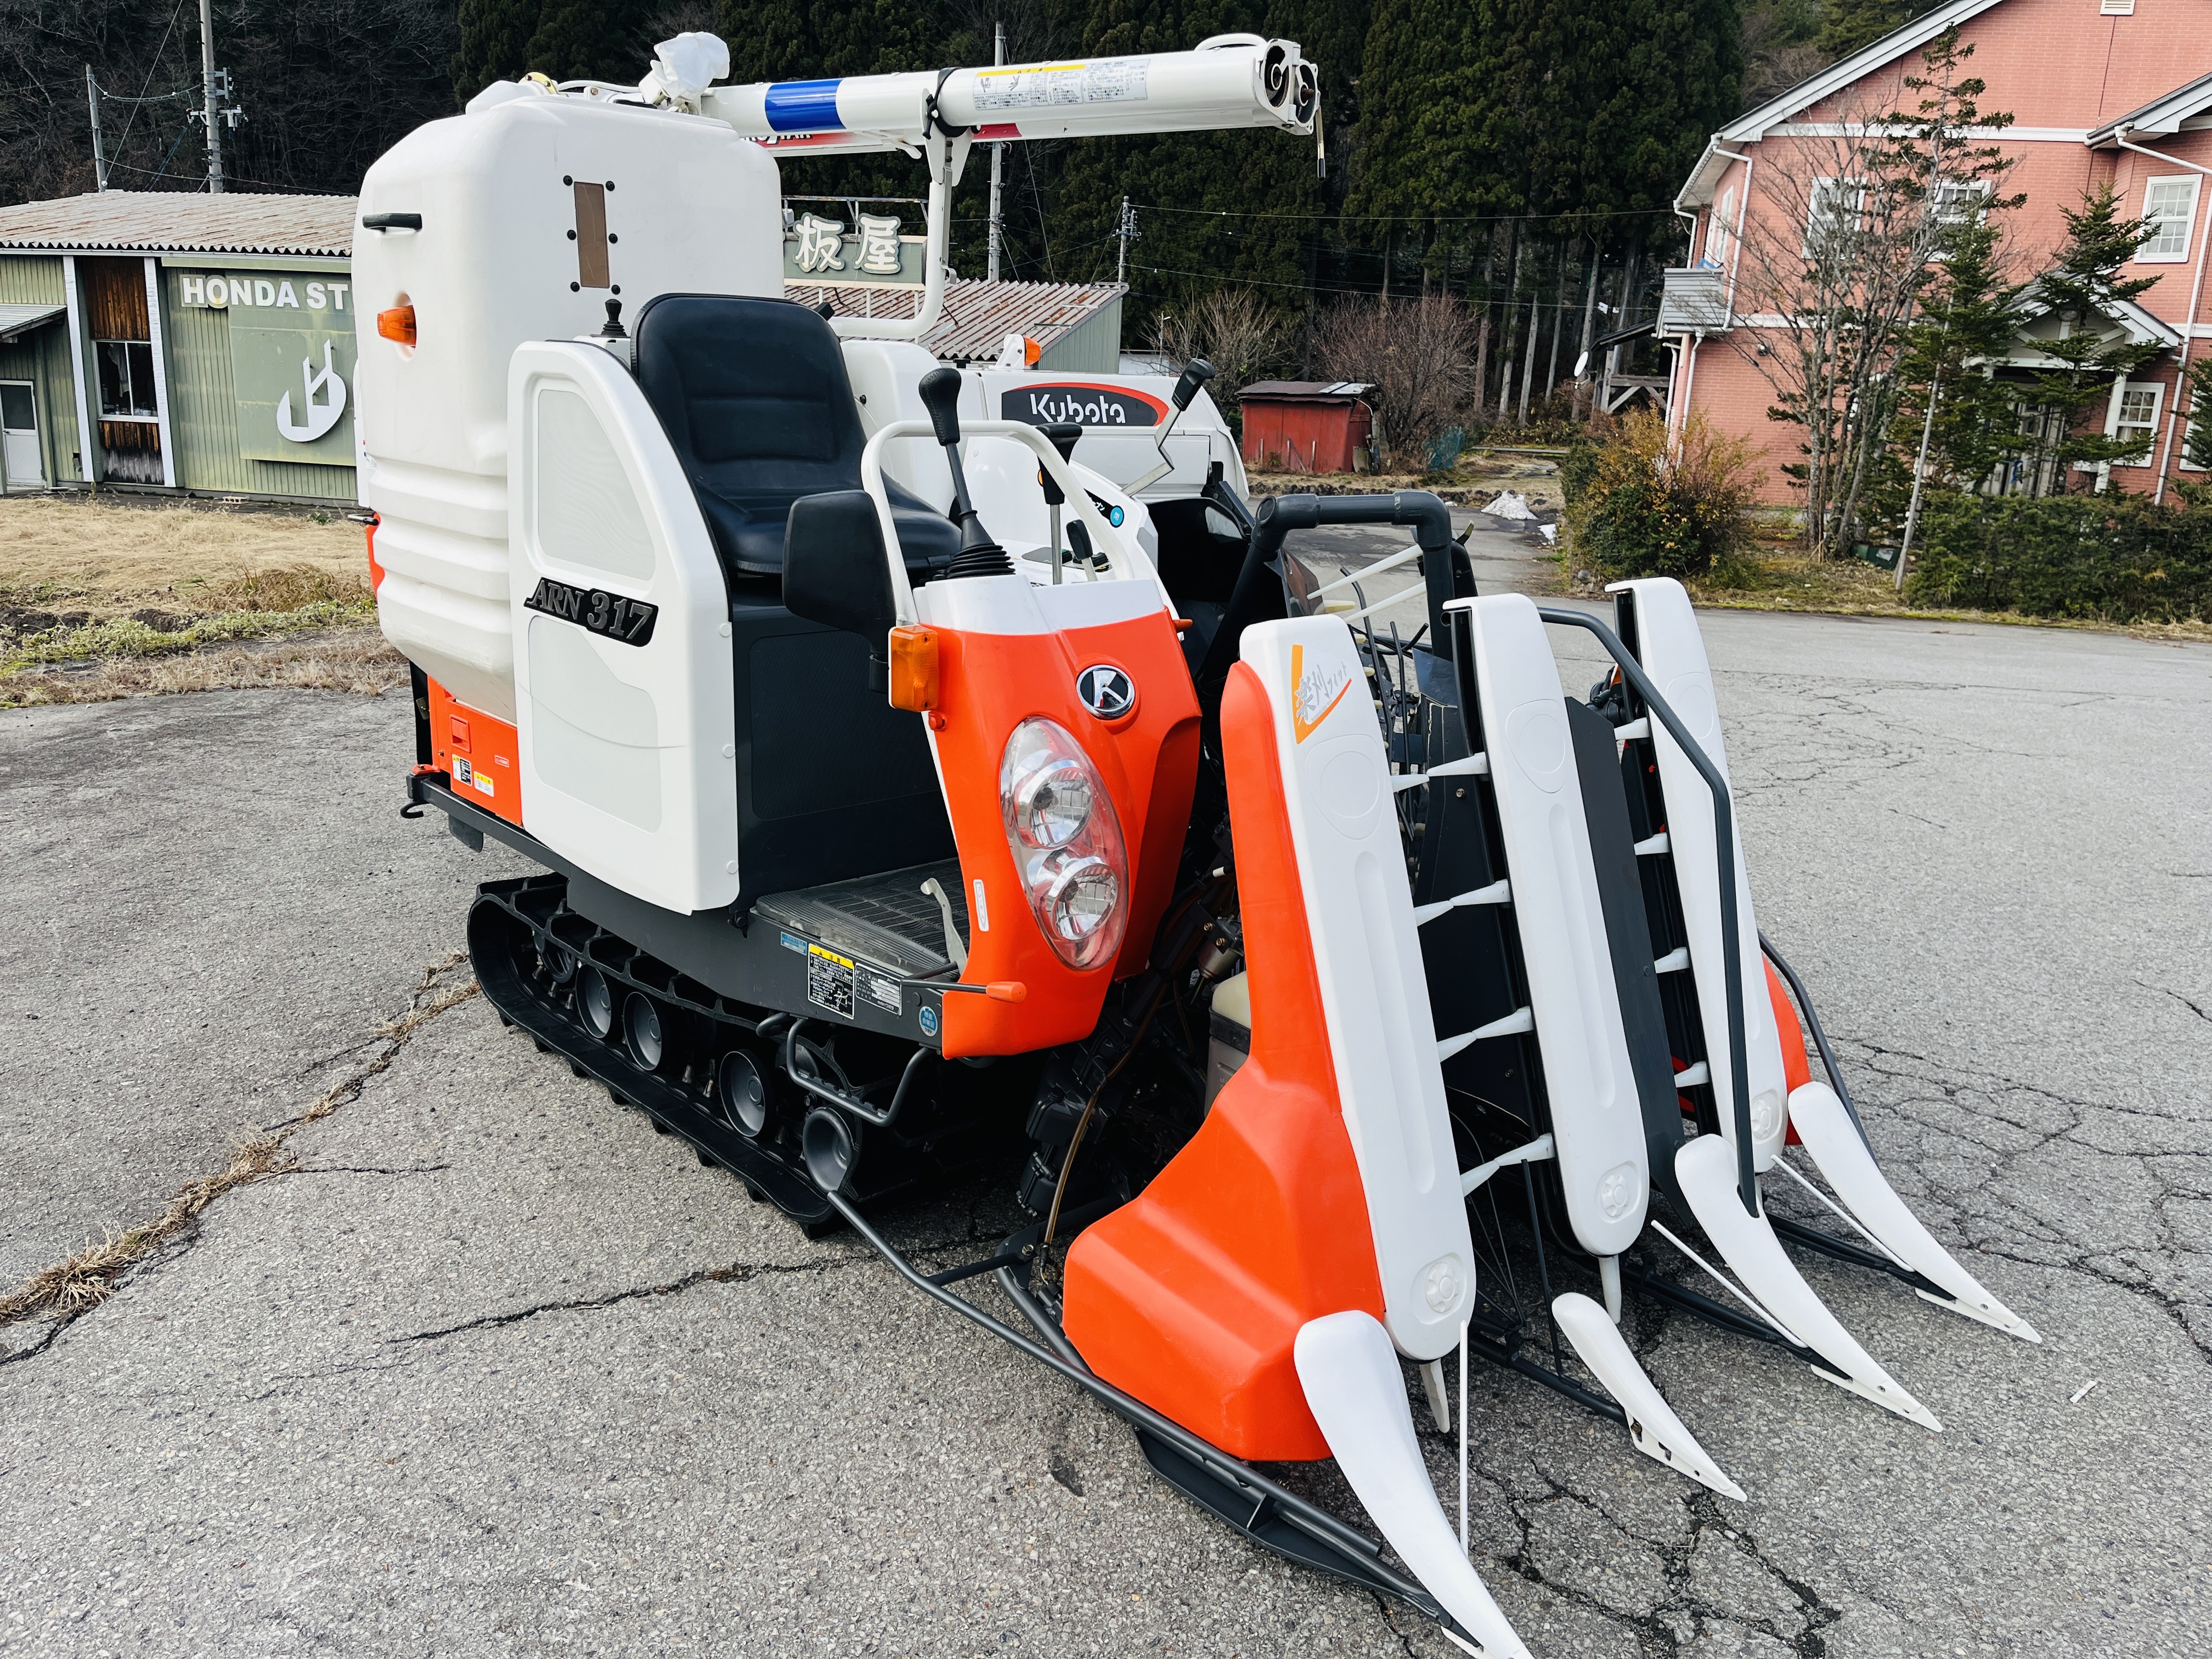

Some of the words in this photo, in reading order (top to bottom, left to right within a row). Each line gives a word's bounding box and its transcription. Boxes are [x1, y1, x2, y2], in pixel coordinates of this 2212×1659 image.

[795, 216, 898, 270] 板屋
[182, 278, 300, 309] HONDA
[306, 282, 349, 310] ST
[1030, 393, 1126, 424] Kubota
[527, 580, 584, 620] ARN
[587, 592, 653, 639] 317
